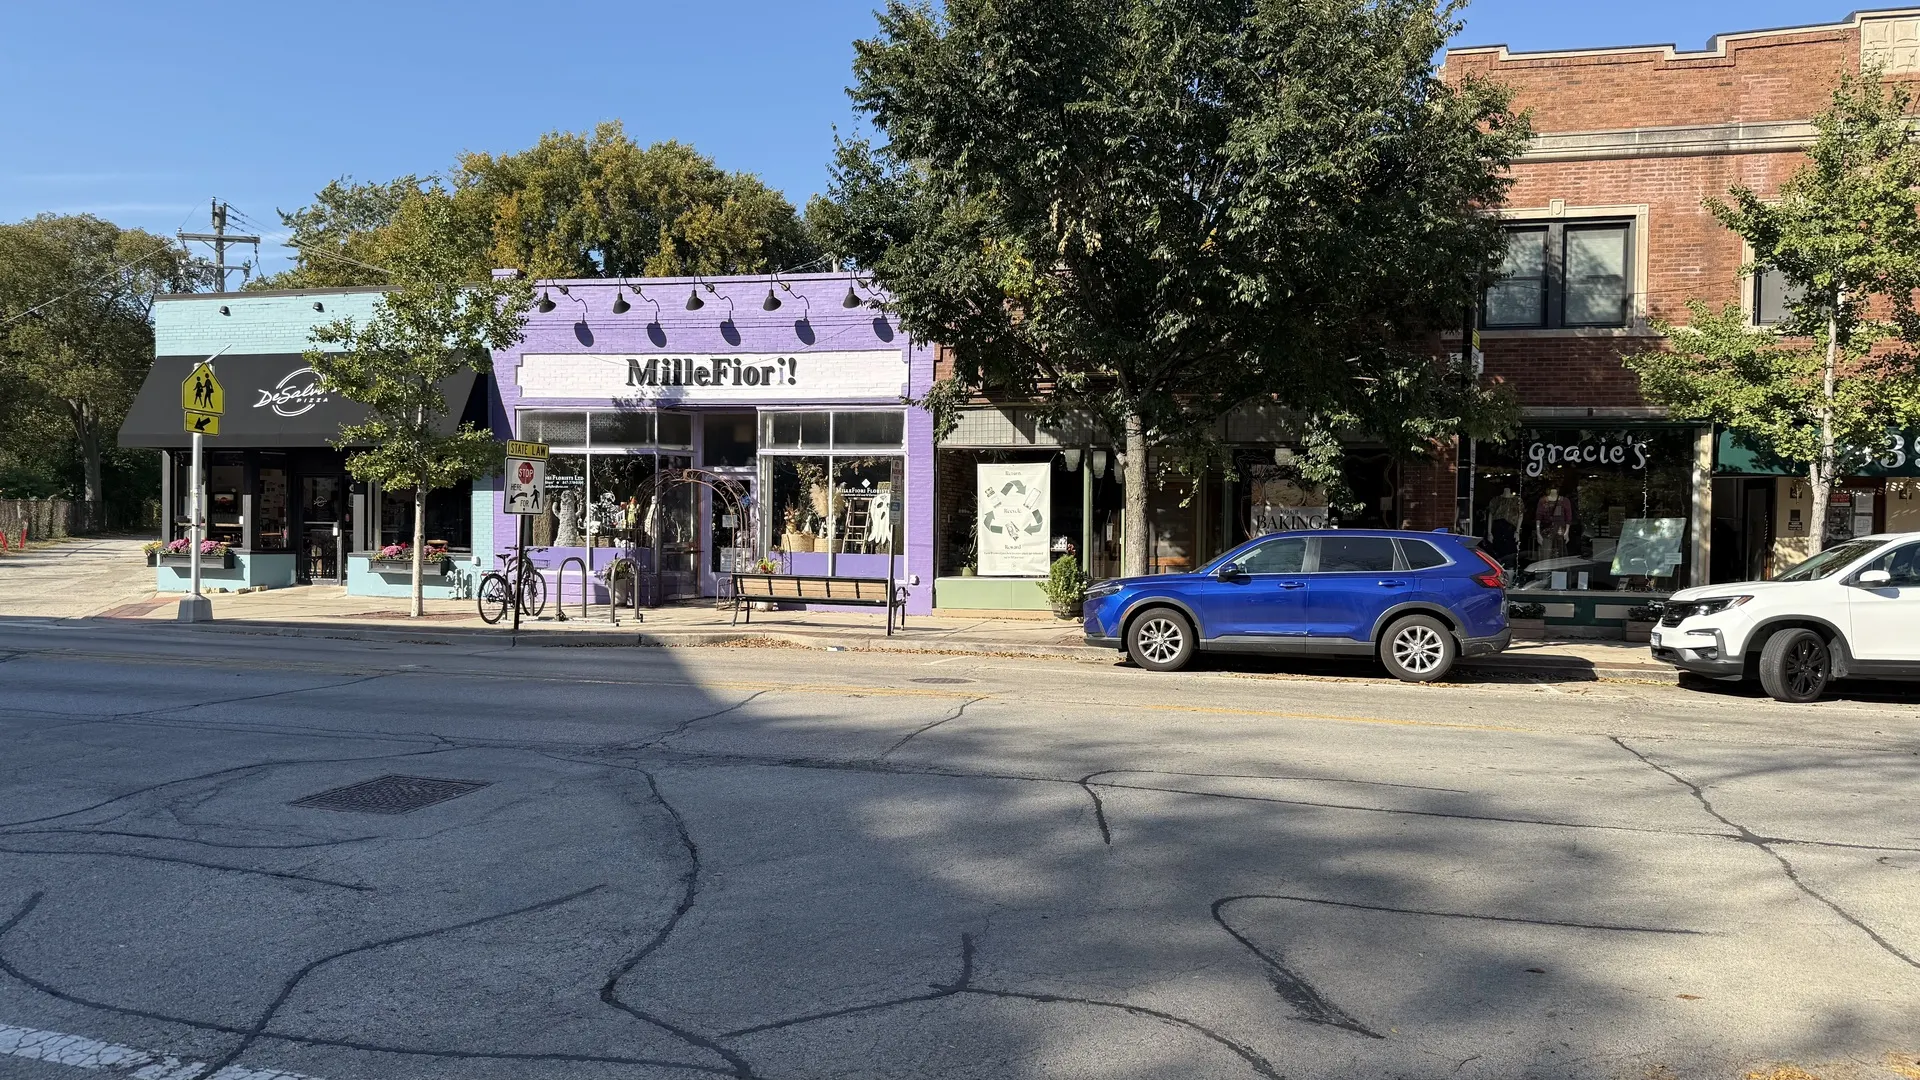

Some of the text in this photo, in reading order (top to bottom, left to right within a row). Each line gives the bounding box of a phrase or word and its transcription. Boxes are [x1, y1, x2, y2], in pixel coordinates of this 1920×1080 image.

[510, 443, 547, 457] STATE LAW
[1526, 435, 1646, 477] gracie's
[518, 468, 534, 478] STOP
[510, 483, 523, 492] HERE
[520, 499, 530, 508] FOR
[1256, 515, 1322, 530] BAKING
